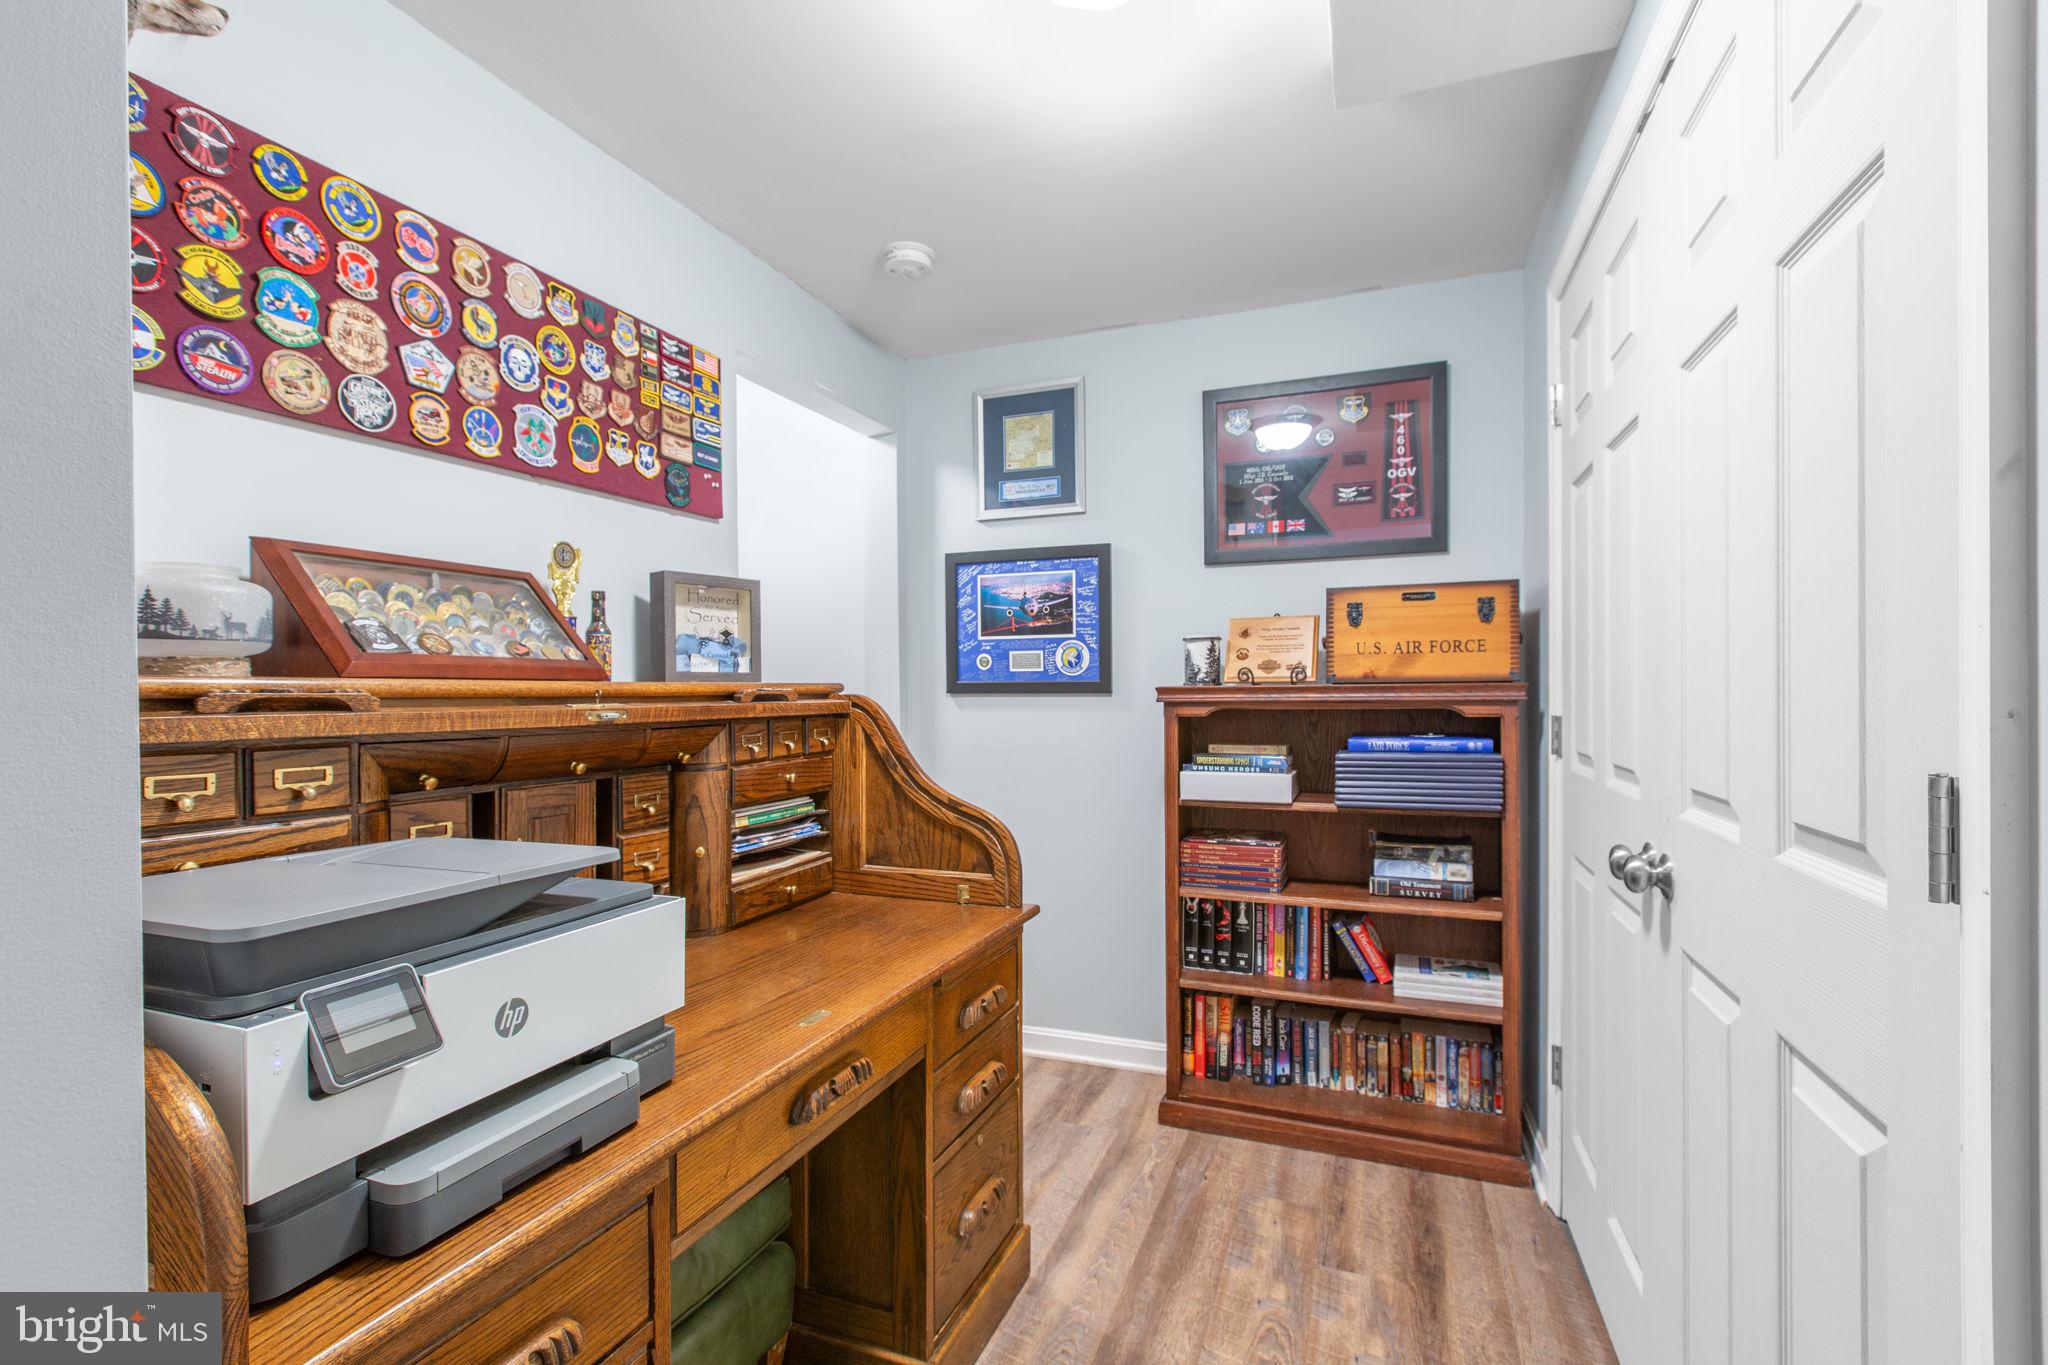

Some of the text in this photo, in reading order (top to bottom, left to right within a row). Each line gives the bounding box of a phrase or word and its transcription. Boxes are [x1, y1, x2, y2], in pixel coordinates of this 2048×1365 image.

[195, 362, 238, 381] STEALTH
[1387, 466, 1417, 479] OGV
[687, 588, 740, 607] Honored
[687, 607, 739, 625] Served
[1356, 639, 1487, 655] U.S. AIR FORCE
[1400, 890, 1442, 899] SURVEY
[1358, 933, 1380, 969] Dictionary
[499, 1000, 526, 1038] hp
[1252, 1005, 1261, 1046] CODE RED
[1279, 1018, 1288, 1051] Jack Carr
